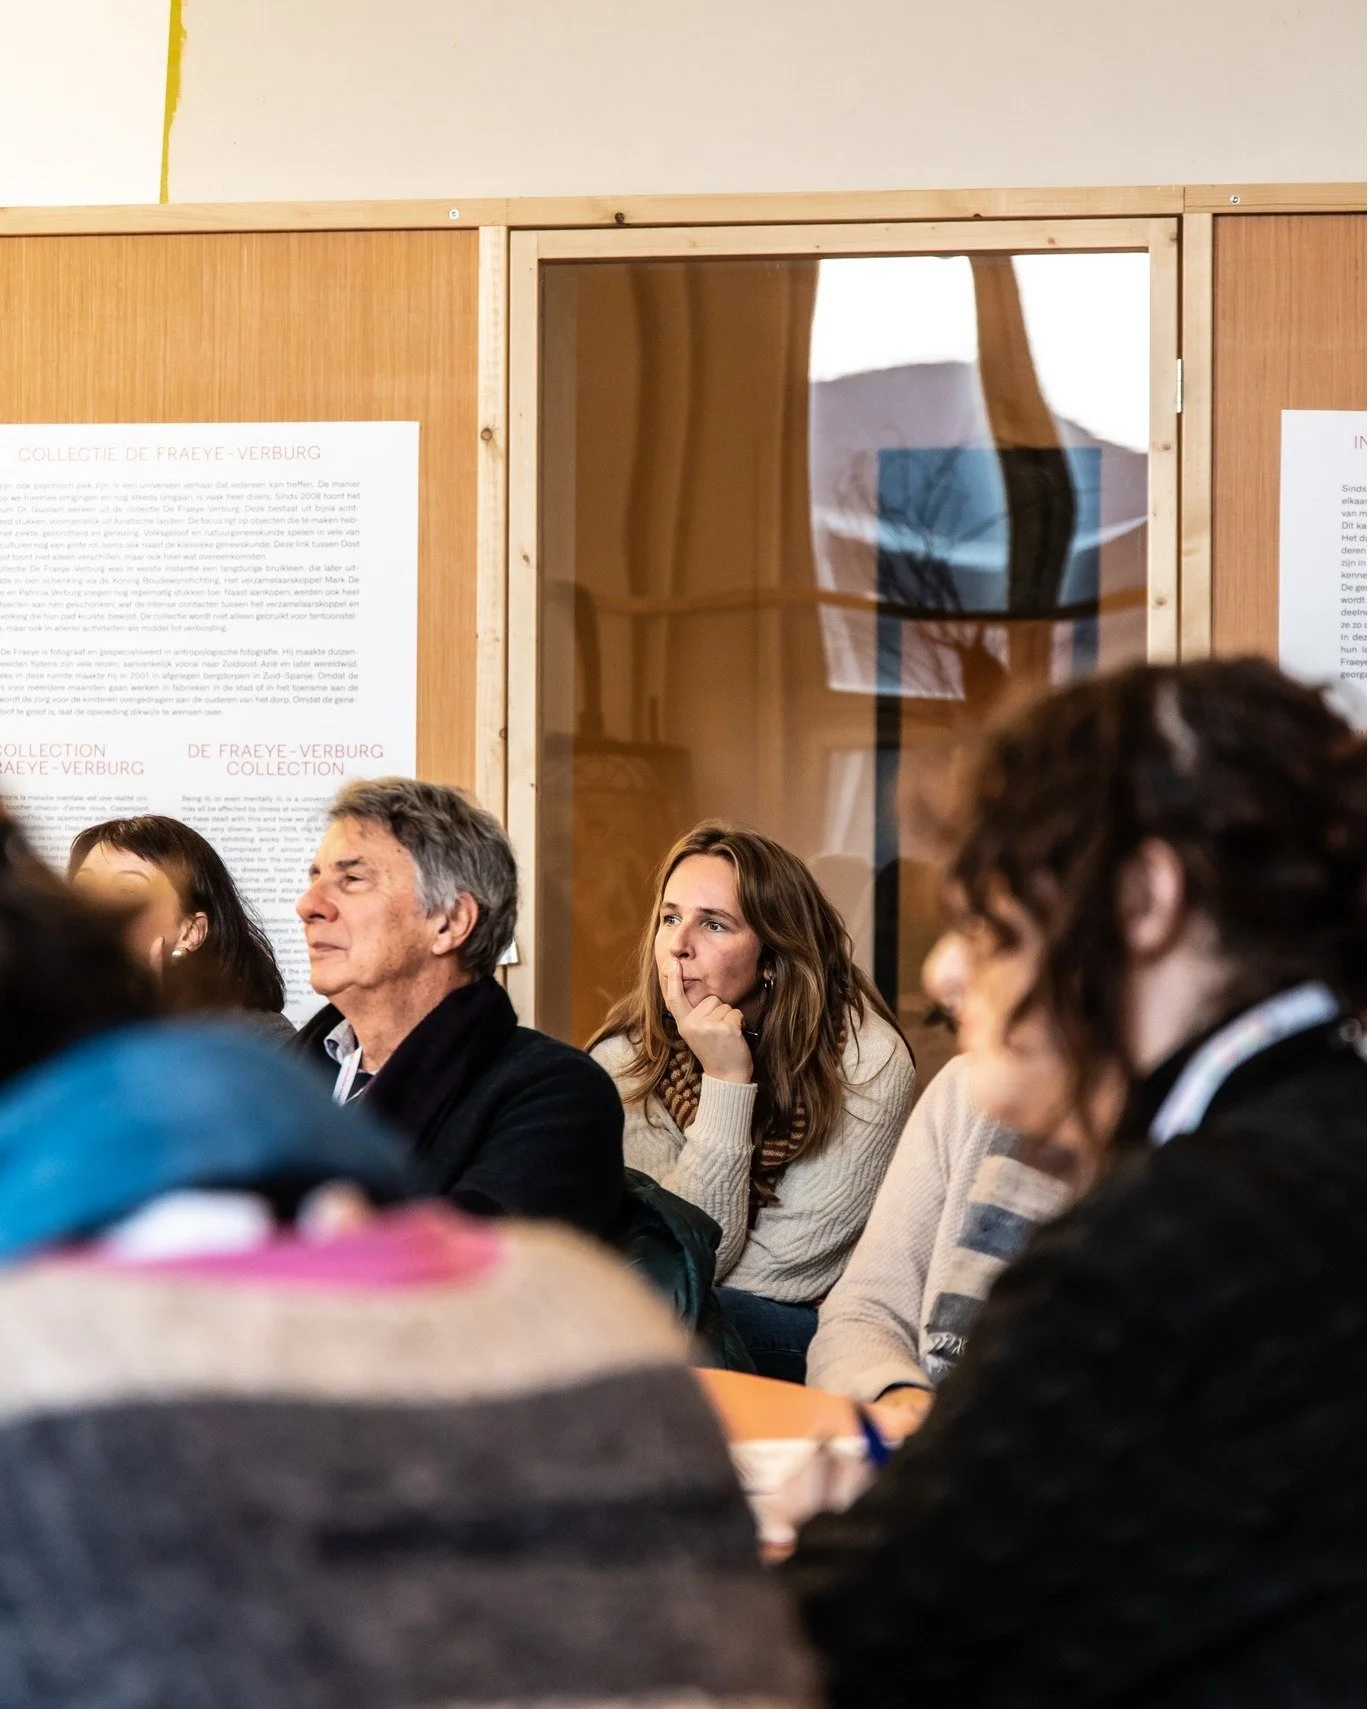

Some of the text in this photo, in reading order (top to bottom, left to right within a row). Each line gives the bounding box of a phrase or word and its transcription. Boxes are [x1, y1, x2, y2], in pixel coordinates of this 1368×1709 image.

[18, 445, 321, 462] COLLECTIE DE FRAEYE-VERBURG
[1342, 484, 1367, 493] Sinds
[1342, 521, 1354, 530] Dit
[1342, 534, 1356, 542] Het
[1341, 546, 1366, 554] deren
[1341, 559, 1356, 568] zijn
[1341, 584, 1354, 592] De
[1341, 596, 1365, 604] wordt
[1341, 646, 1357, 654] hun
[188, 743, 384, 758] DE FRAEYE-VERBURG
[226, 761, 344, 776] COLLECTION
